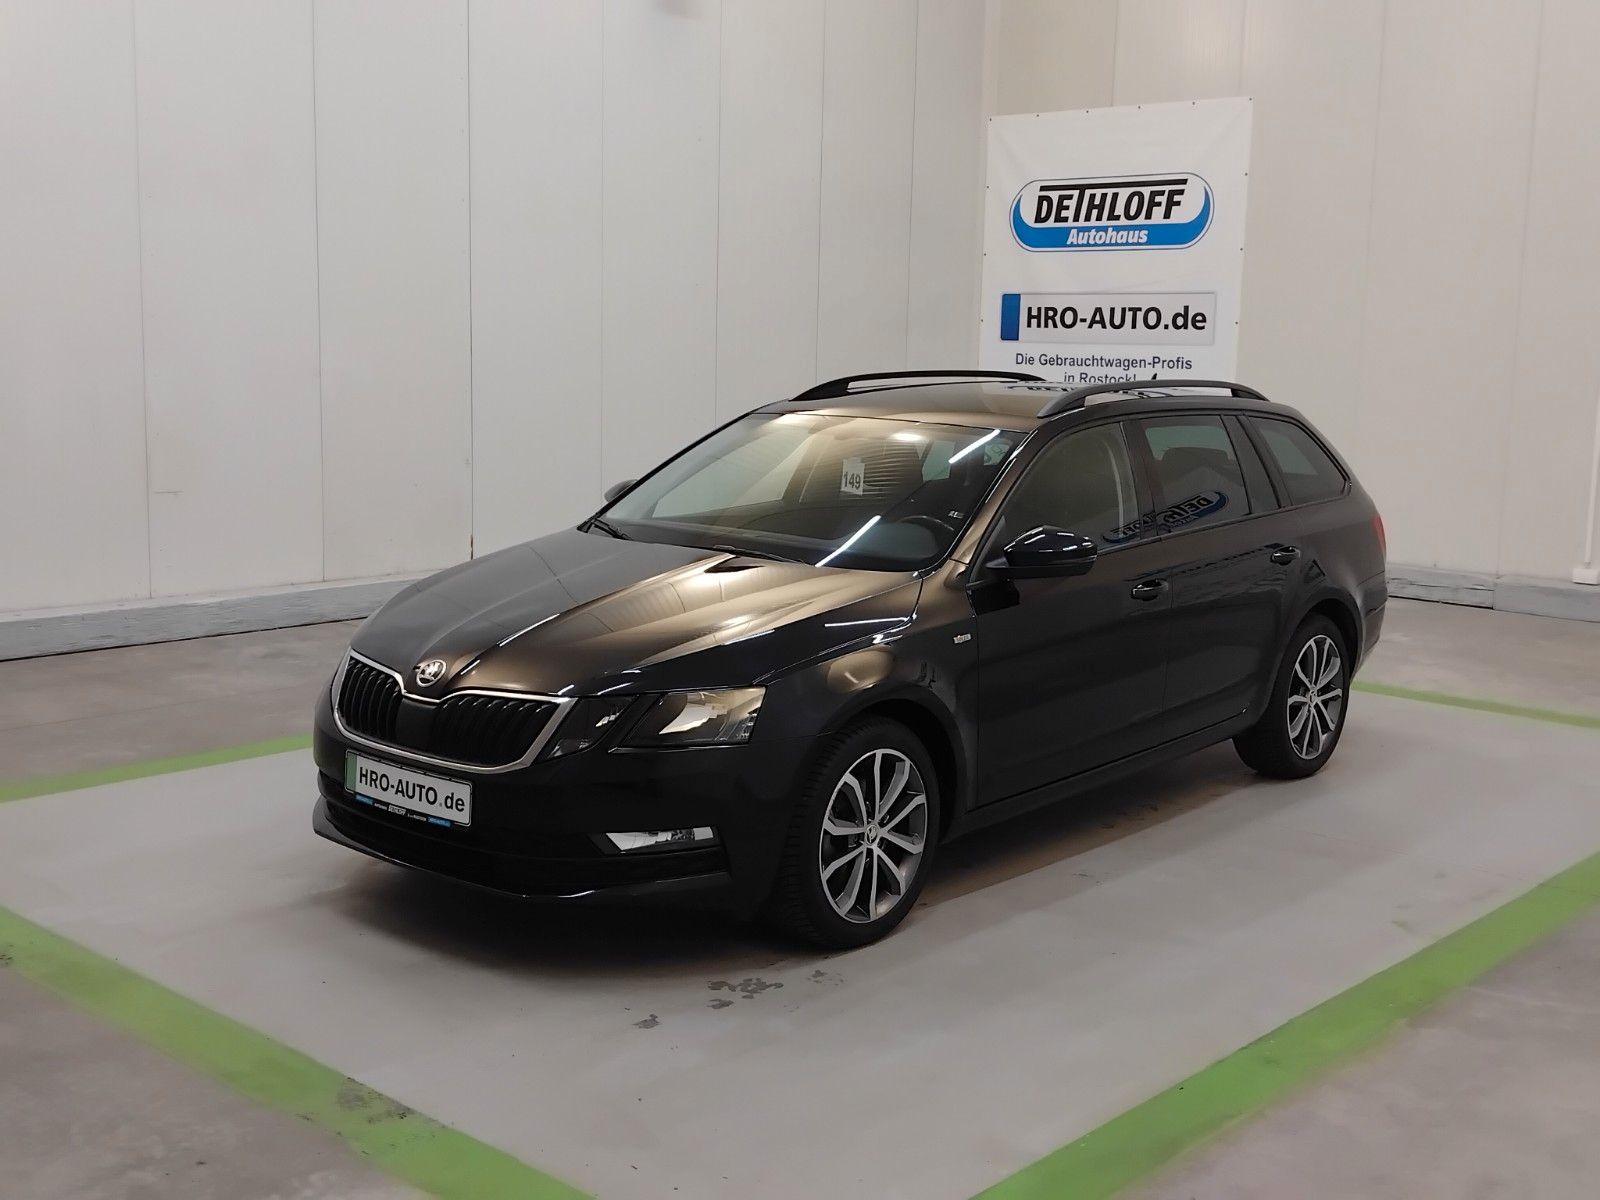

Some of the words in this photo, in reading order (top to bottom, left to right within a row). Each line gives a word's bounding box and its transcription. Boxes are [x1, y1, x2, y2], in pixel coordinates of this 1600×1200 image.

[1033, 178, 1188, 224] DETHLOFF
[1066, 227, 1148, 245] Autohaus
[1026, 305, 1207, 330] HRO-AUTO.de
[1015, 353, 1035, 366] Die
[1038, 353, 1193, 371] Gebrauchtwagen-Profis
[1064, 372, 1075, 382] in
[843, 471, 861, 490] 149
[359, 766, 465, 813] HRO-AUTO.de
